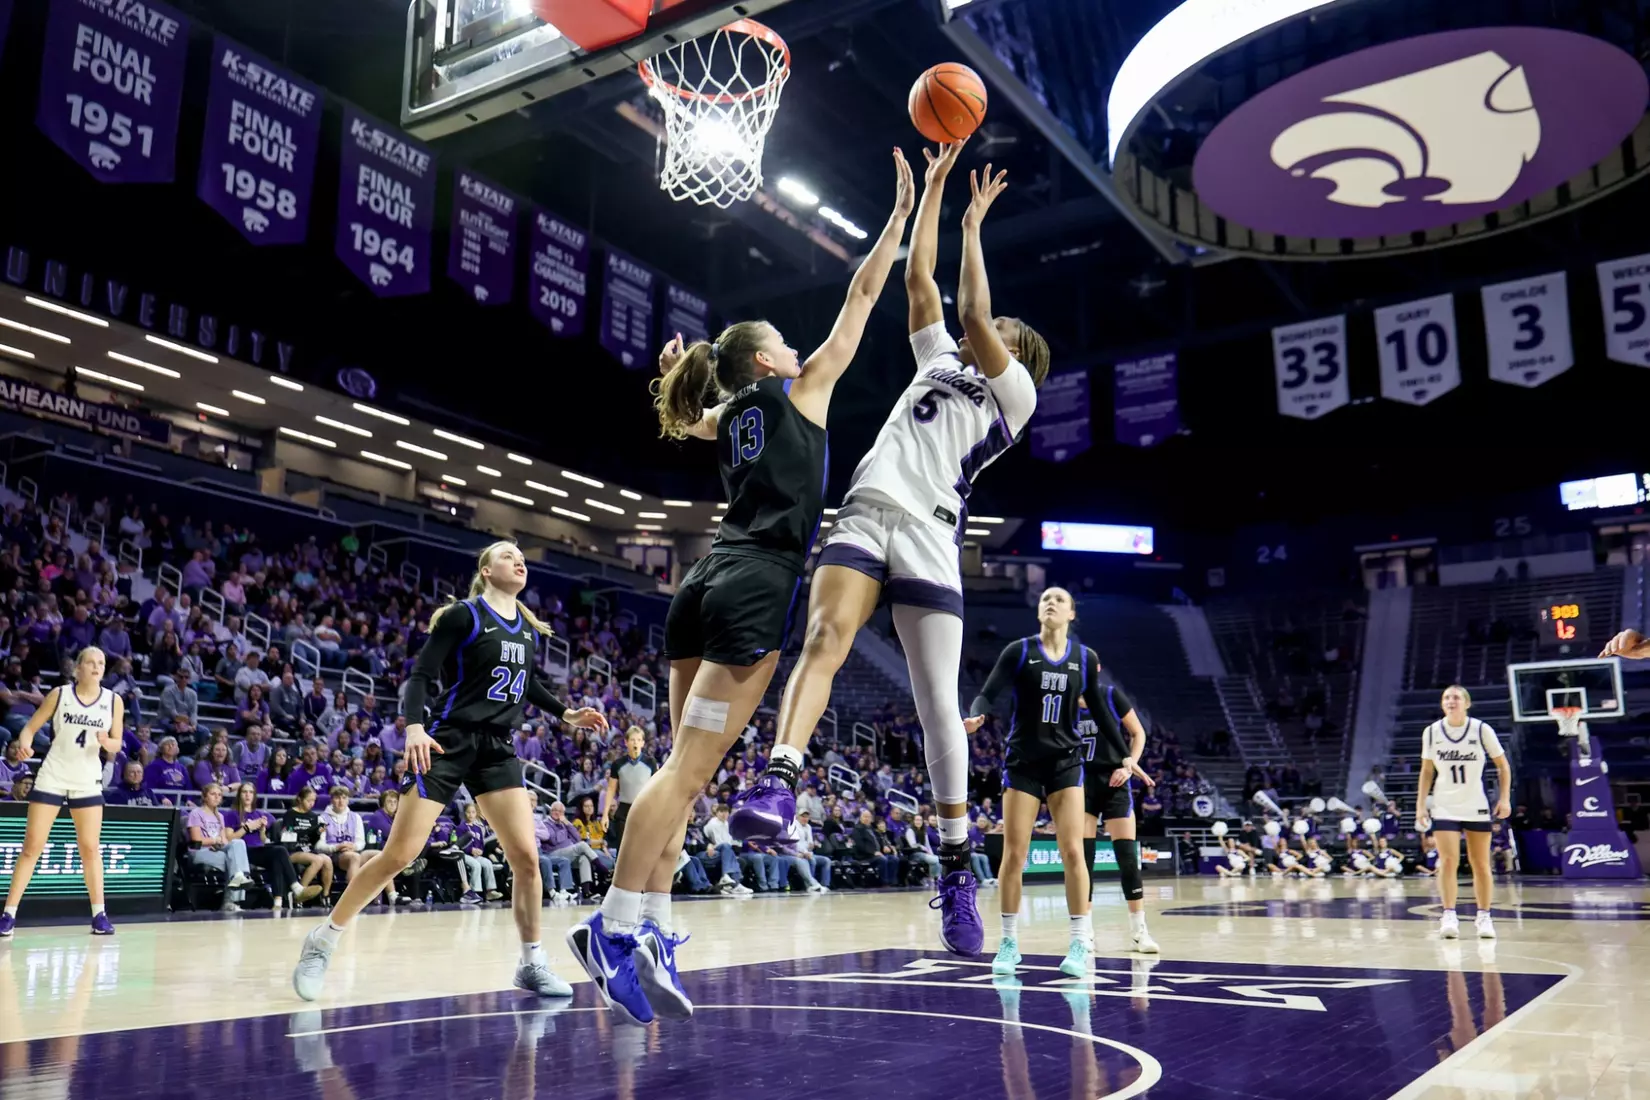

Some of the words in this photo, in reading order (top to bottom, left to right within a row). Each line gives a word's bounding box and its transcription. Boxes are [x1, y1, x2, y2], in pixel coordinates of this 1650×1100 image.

[72, 46, 153, 107] FOUR
[76, 21, 157, 84] FINAL
[221, 48, 316, 112] K-STATE
[66, 92, 154, 159] 1951
[228, 120, 294, 174] FOUR
[231, 98, 298, 152] FINAL
[351, 117, 431, 173] K-STATE
[221, 162, 297, 219] 1958
[356, 184, 413, 231] FOUR
[358, 162, 416, 211] FINAL
[349, 221, 415, 274] 1964
[539, 284, 578, 319] 2019
[1384, 320, 1449, 373] 10
[1511, 302, 1545, 352] 3
[1281, 341, 1341, 391] 33
[911, 387, 952, 425] 5
[728, 405, 765, 469] 13
[1493, 514, 1533, 538] 25
[1254, 543, 1289, 565] 24
[499, 638, 526, 665] BYU
[486, 664, 527, 704] 24
[1041, 670, 1069, 692] BYU
[63, 711, 104, 729] Wildcats
[1041, 692, 1063, 724] 11
[75, 728, 87, 749] 4
[1436, 749, 1478, 761] Wildcats
[1450, 764, 1466, 784] 11
